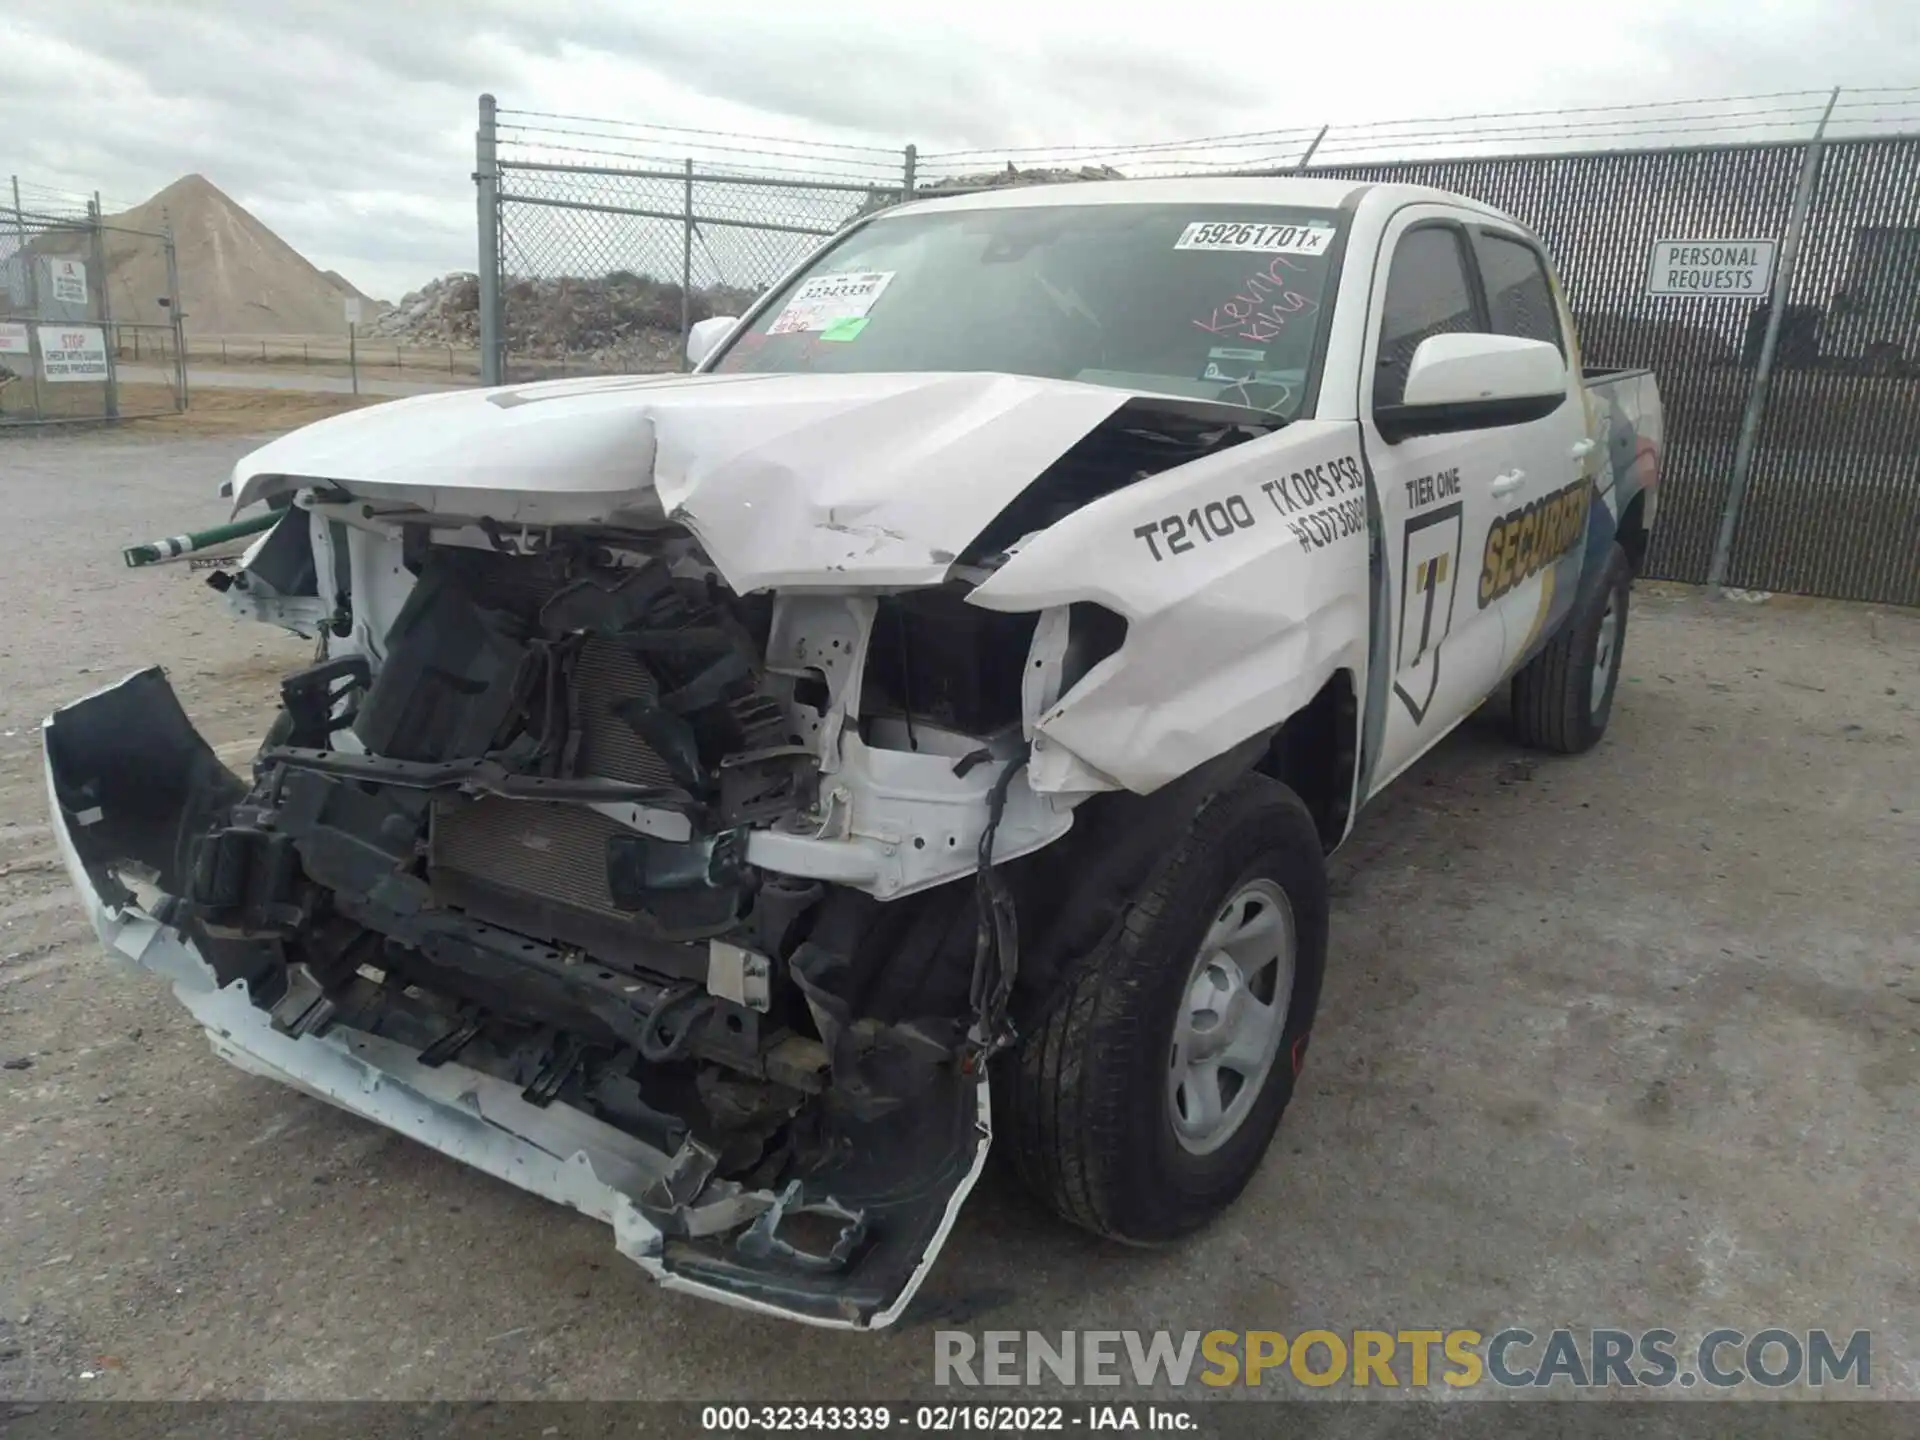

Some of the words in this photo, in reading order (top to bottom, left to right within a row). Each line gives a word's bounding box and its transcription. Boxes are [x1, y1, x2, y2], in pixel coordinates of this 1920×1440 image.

[1668, 247, 1758, 267] PERSONAL
[1667, 270, 1753, 290] REQUESTS
[61, 333, 86, 349] STOP
[1404, 474, 1436, 510] TIER
[1436, 467, 1462, 499] ONE
[1133, 494, 1256, 562] T2100
[1261, 477, 1303, 516] TX
[1290, 465, 1336, 507] DPS
[1327, 455, 1364, 494] PSB
